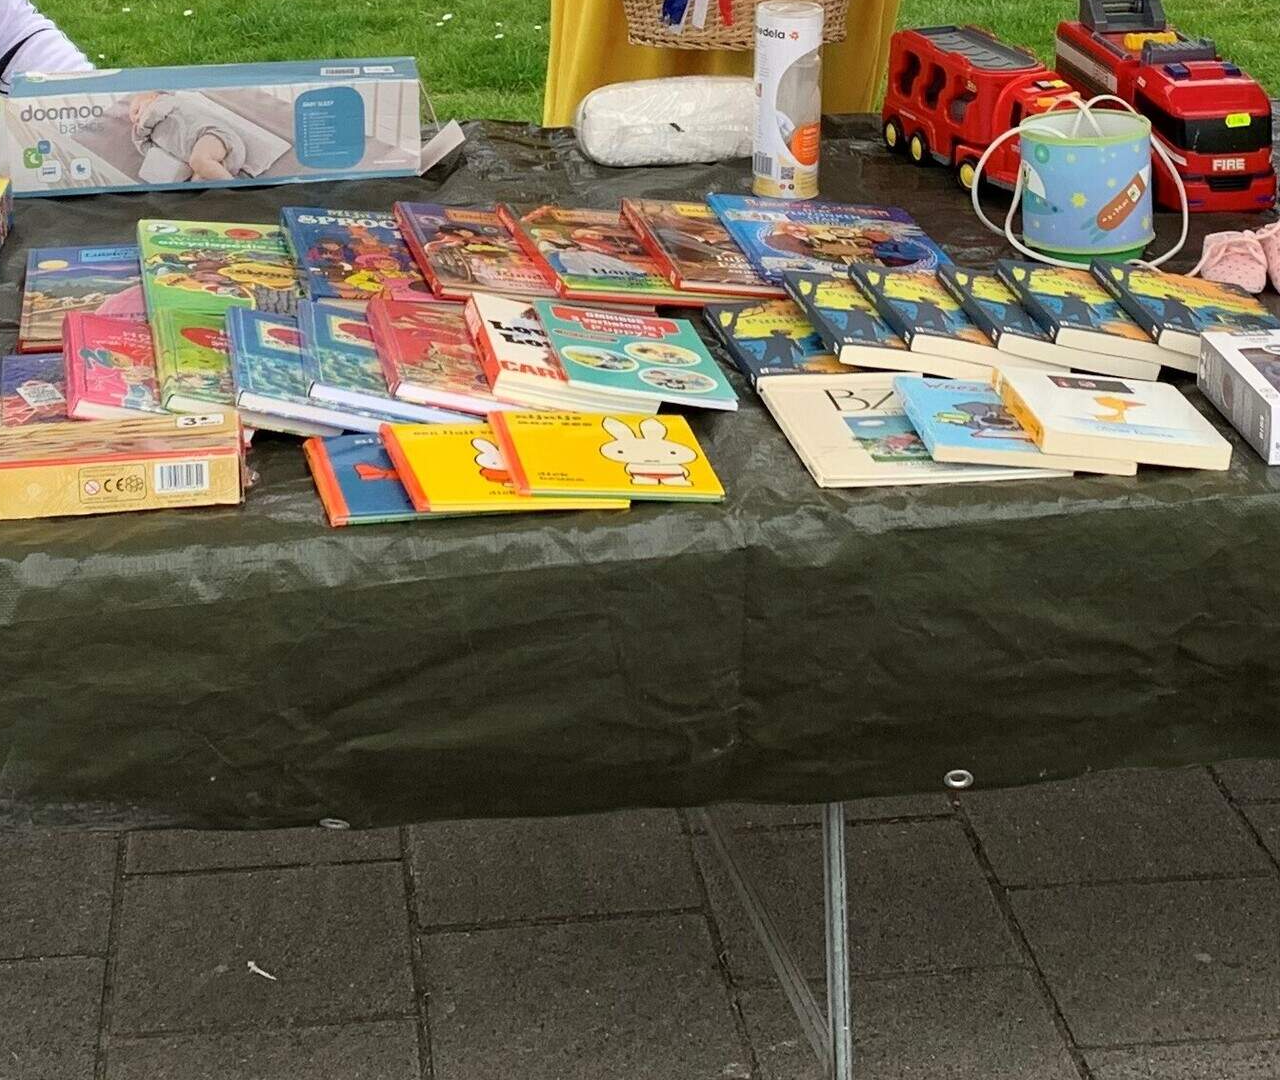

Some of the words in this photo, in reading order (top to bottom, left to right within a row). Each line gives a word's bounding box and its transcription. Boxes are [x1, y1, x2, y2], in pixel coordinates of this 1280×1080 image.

[758, 27, 786, 40] edela
[20, 105, 104, 122] doomoo
[59, 122, 105, 135] basics
[1212, 158, 1246, 171] FIRE
